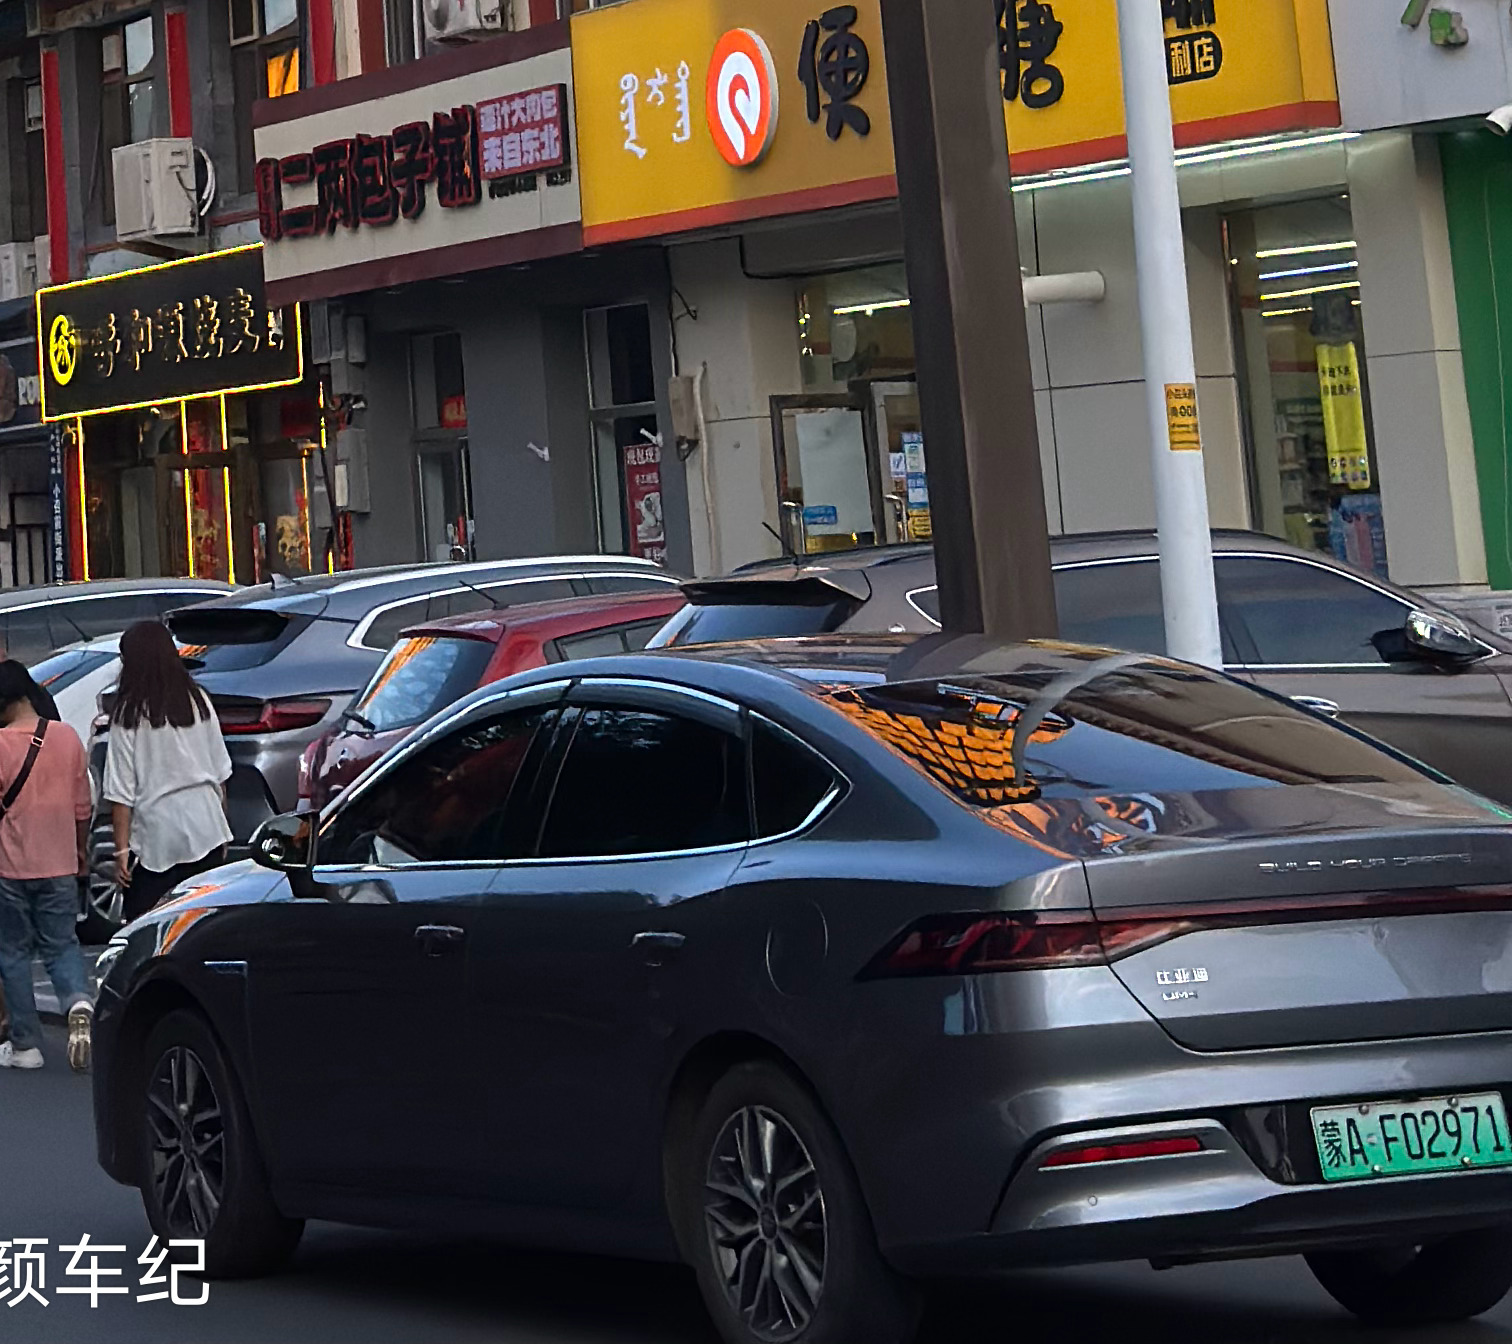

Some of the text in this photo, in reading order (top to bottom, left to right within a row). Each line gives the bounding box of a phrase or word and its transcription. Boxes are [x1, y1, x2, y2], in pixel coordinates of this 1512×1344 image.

[1169, 36, 1216, 78] 利店
[483, 123, 560, 173] 来自东北
[1156, 967, 1209, 985] 比亚迪
